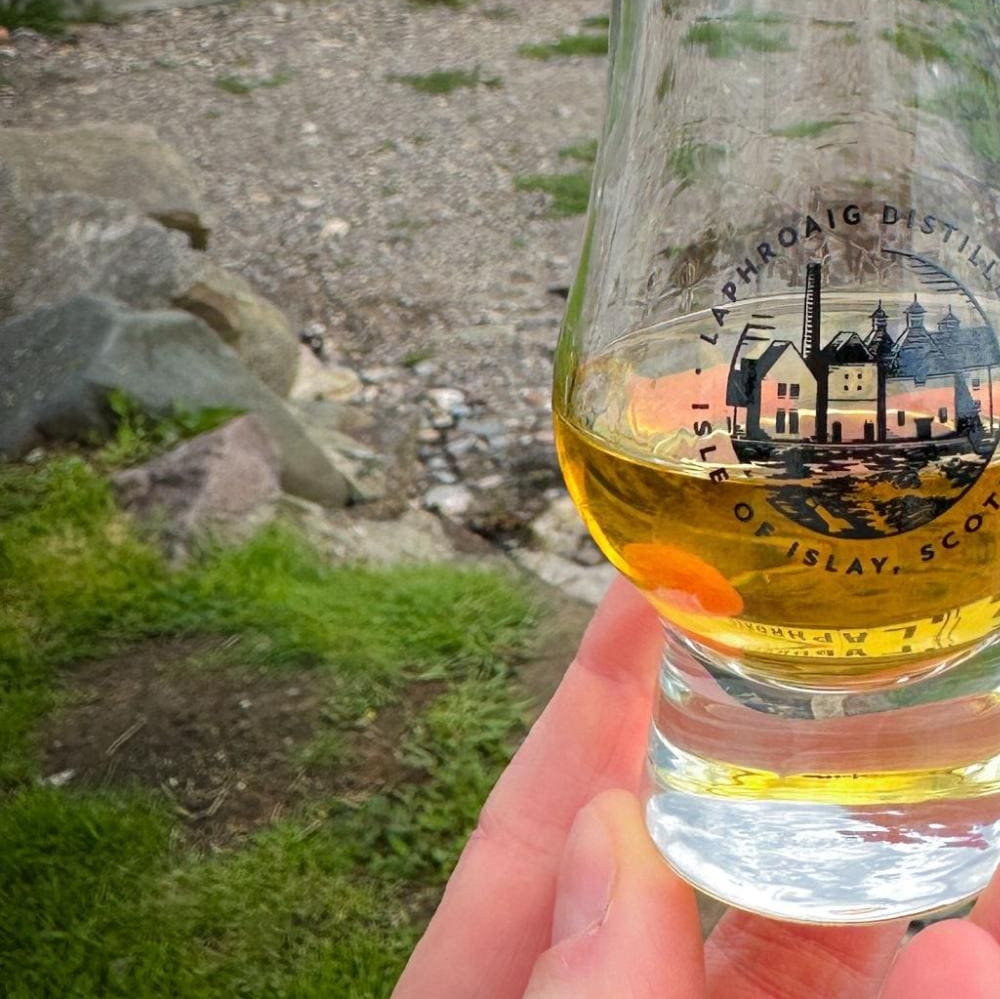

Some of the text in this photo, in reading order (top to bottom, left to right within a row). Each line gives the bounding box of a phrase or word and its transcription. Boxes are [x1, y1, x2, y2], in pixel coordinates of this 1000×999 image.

[701, 204, 860, 346] LAPHROAIG
[691, 403, 730, 485] ISLE
[734, 502, 775, 537] OF
